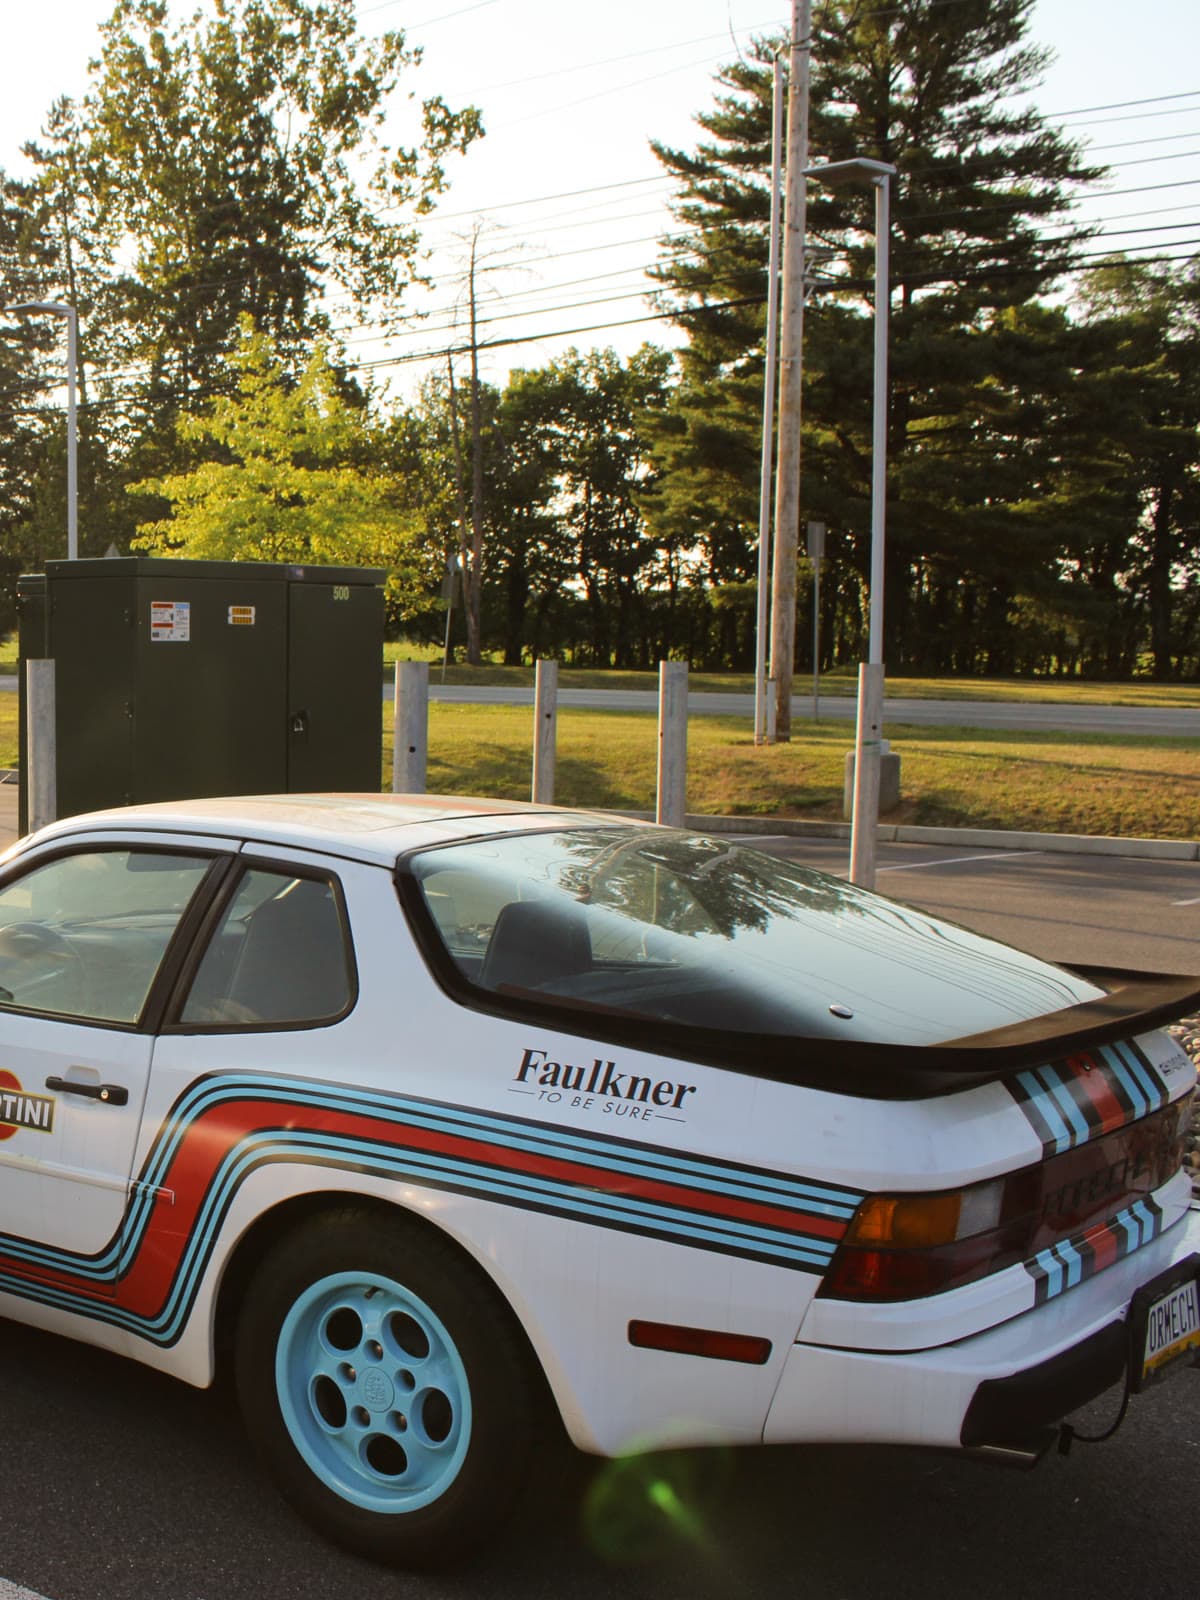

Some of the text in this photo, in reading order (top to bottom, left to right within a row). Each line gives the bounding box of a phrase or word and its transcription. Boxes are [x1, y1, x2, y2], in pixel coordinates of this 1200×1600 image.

[333, 585, 350, 600] 500
[512, 1048, 696, 1109] Faulkner
[538, 1090, 653, 1121] TO BE SURE
